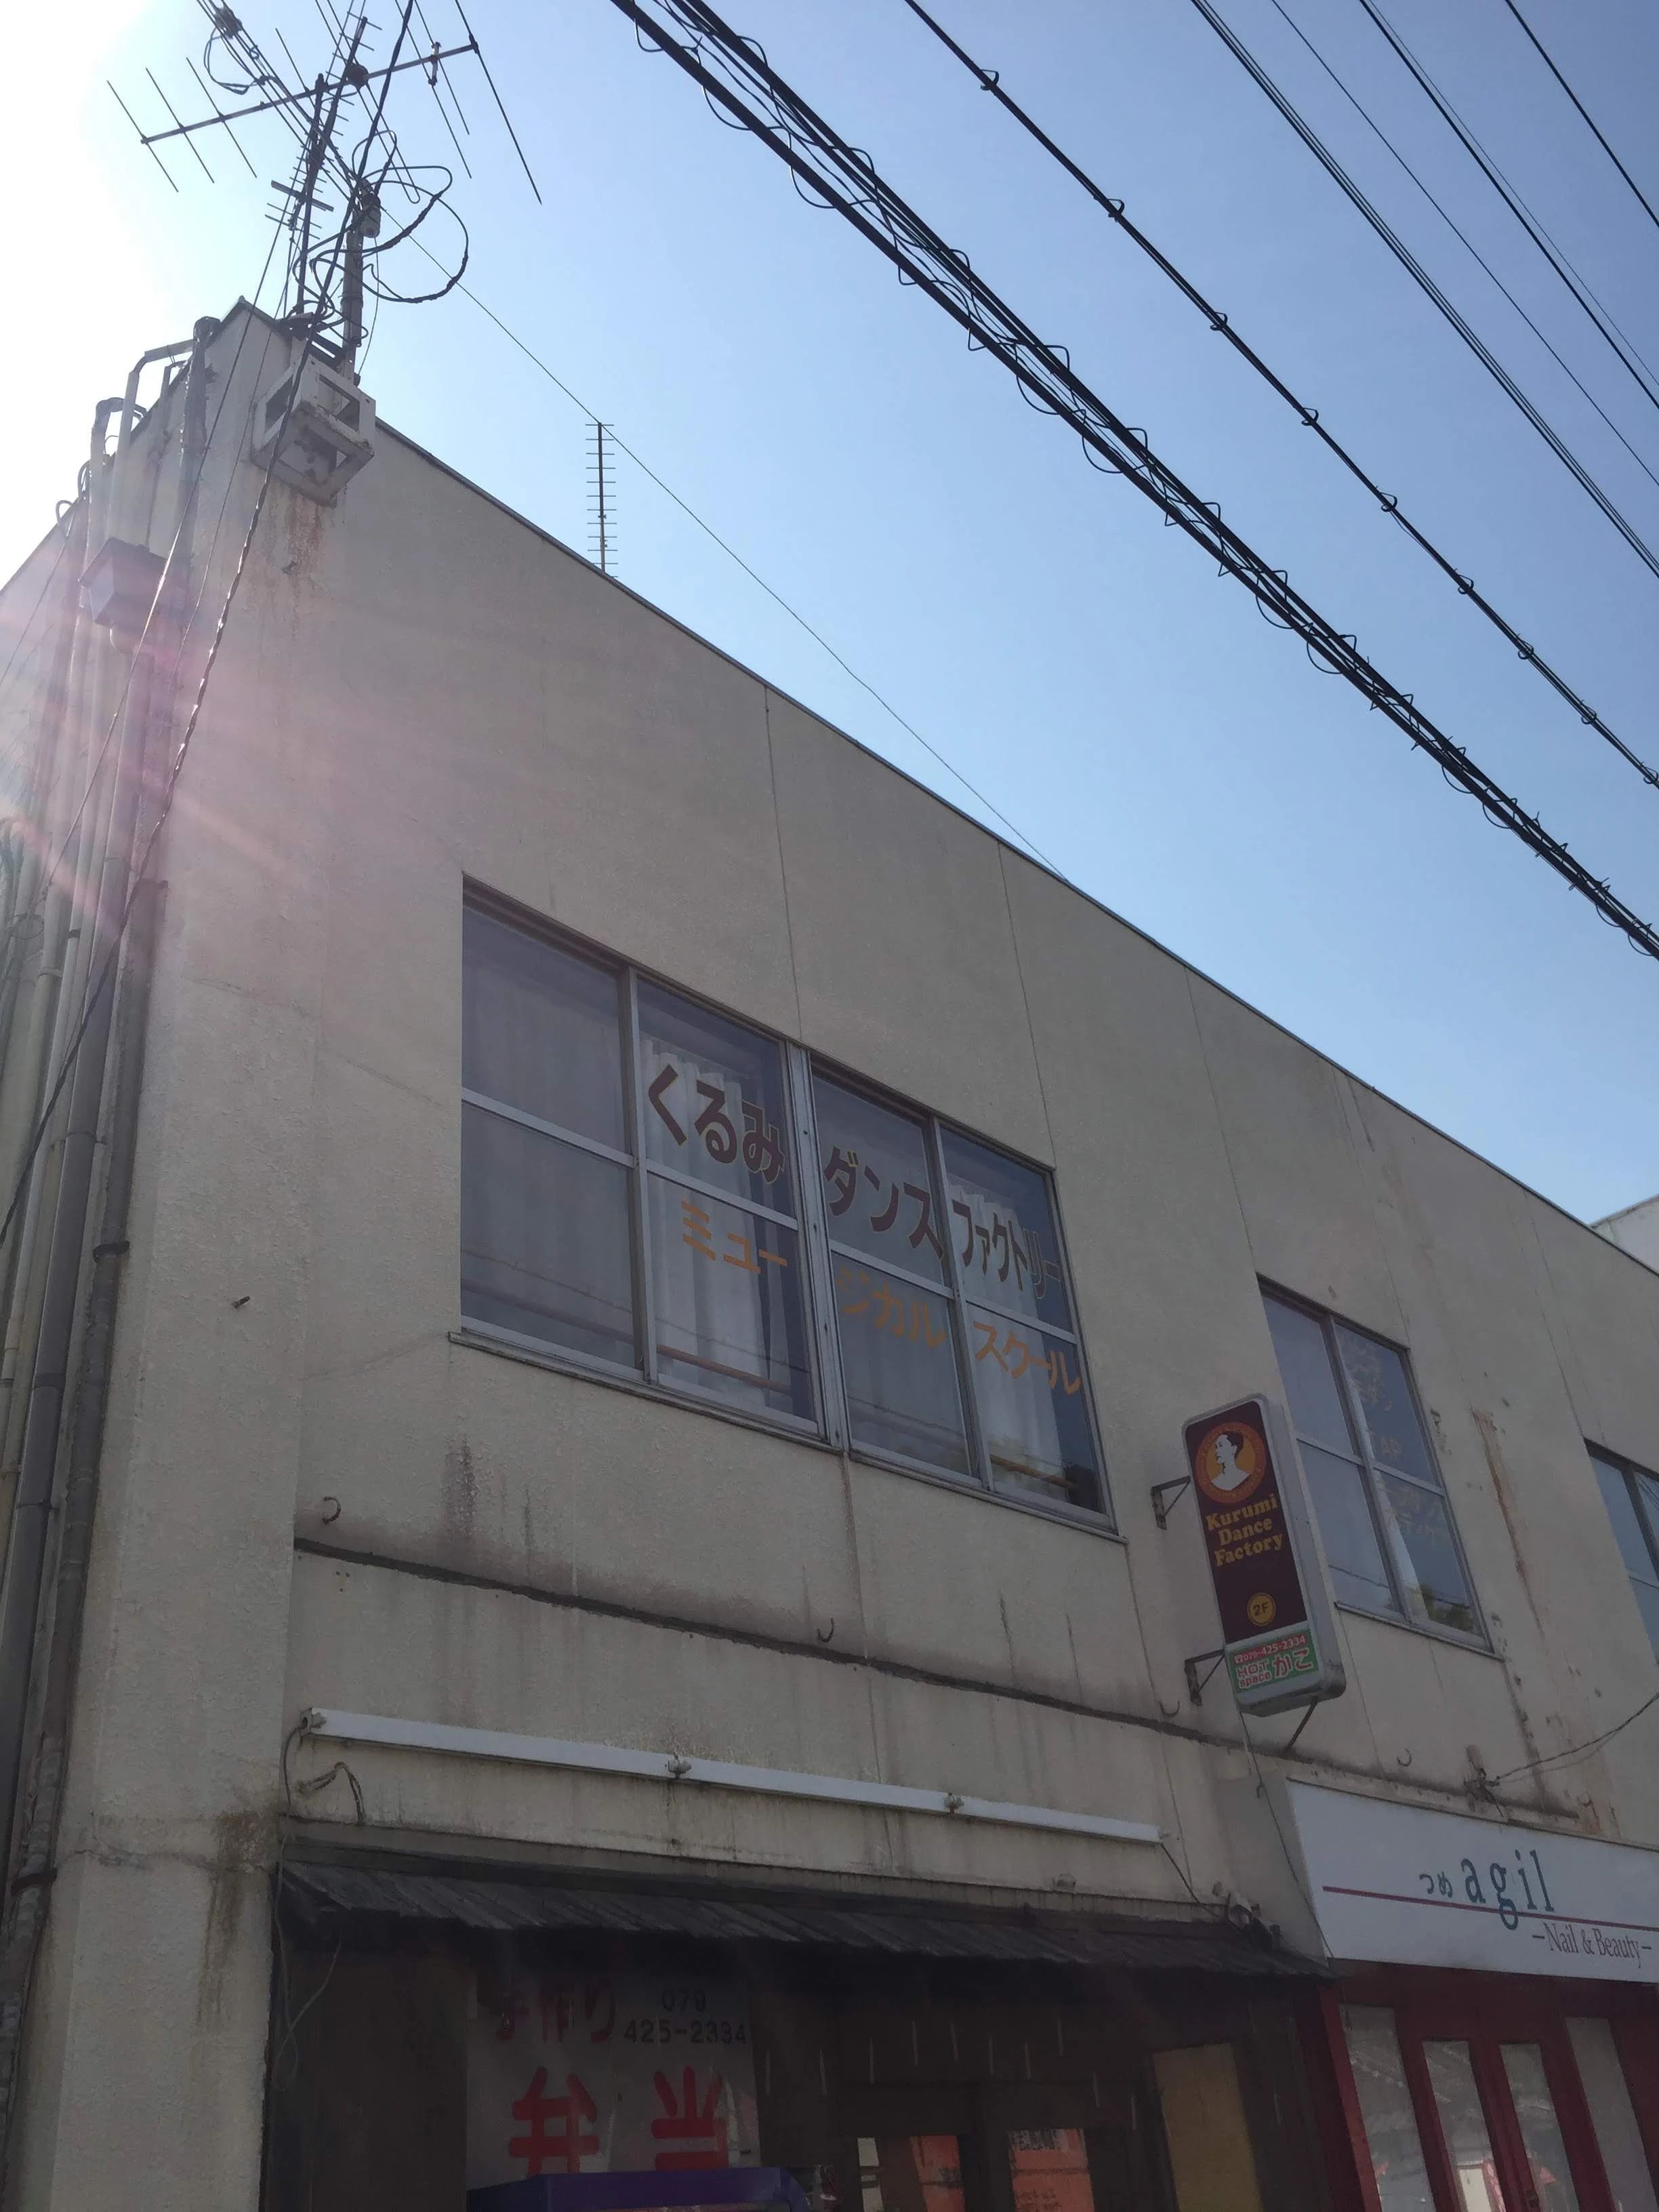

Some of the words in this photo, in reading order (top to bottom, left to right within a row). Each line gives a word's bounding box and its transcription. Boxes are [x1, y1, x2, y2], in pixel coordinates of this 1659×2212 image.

[647, 1064, 785, 1185] くるみ
[1205, 1493, 1279, 1531] Kurumi
[1218, 1517, 1273, 1546] Dance
[1214, 1533, 1285, 1568] Factory
[1253, 1601, 1269, 1616] 2F
[1237, 1660, 1268, 1679] HOT
[1239, 1672, 1272, 1689] space
[1460, 1849, 1555, 1931] agil
[1581, 1929, 1595, 1955] &
